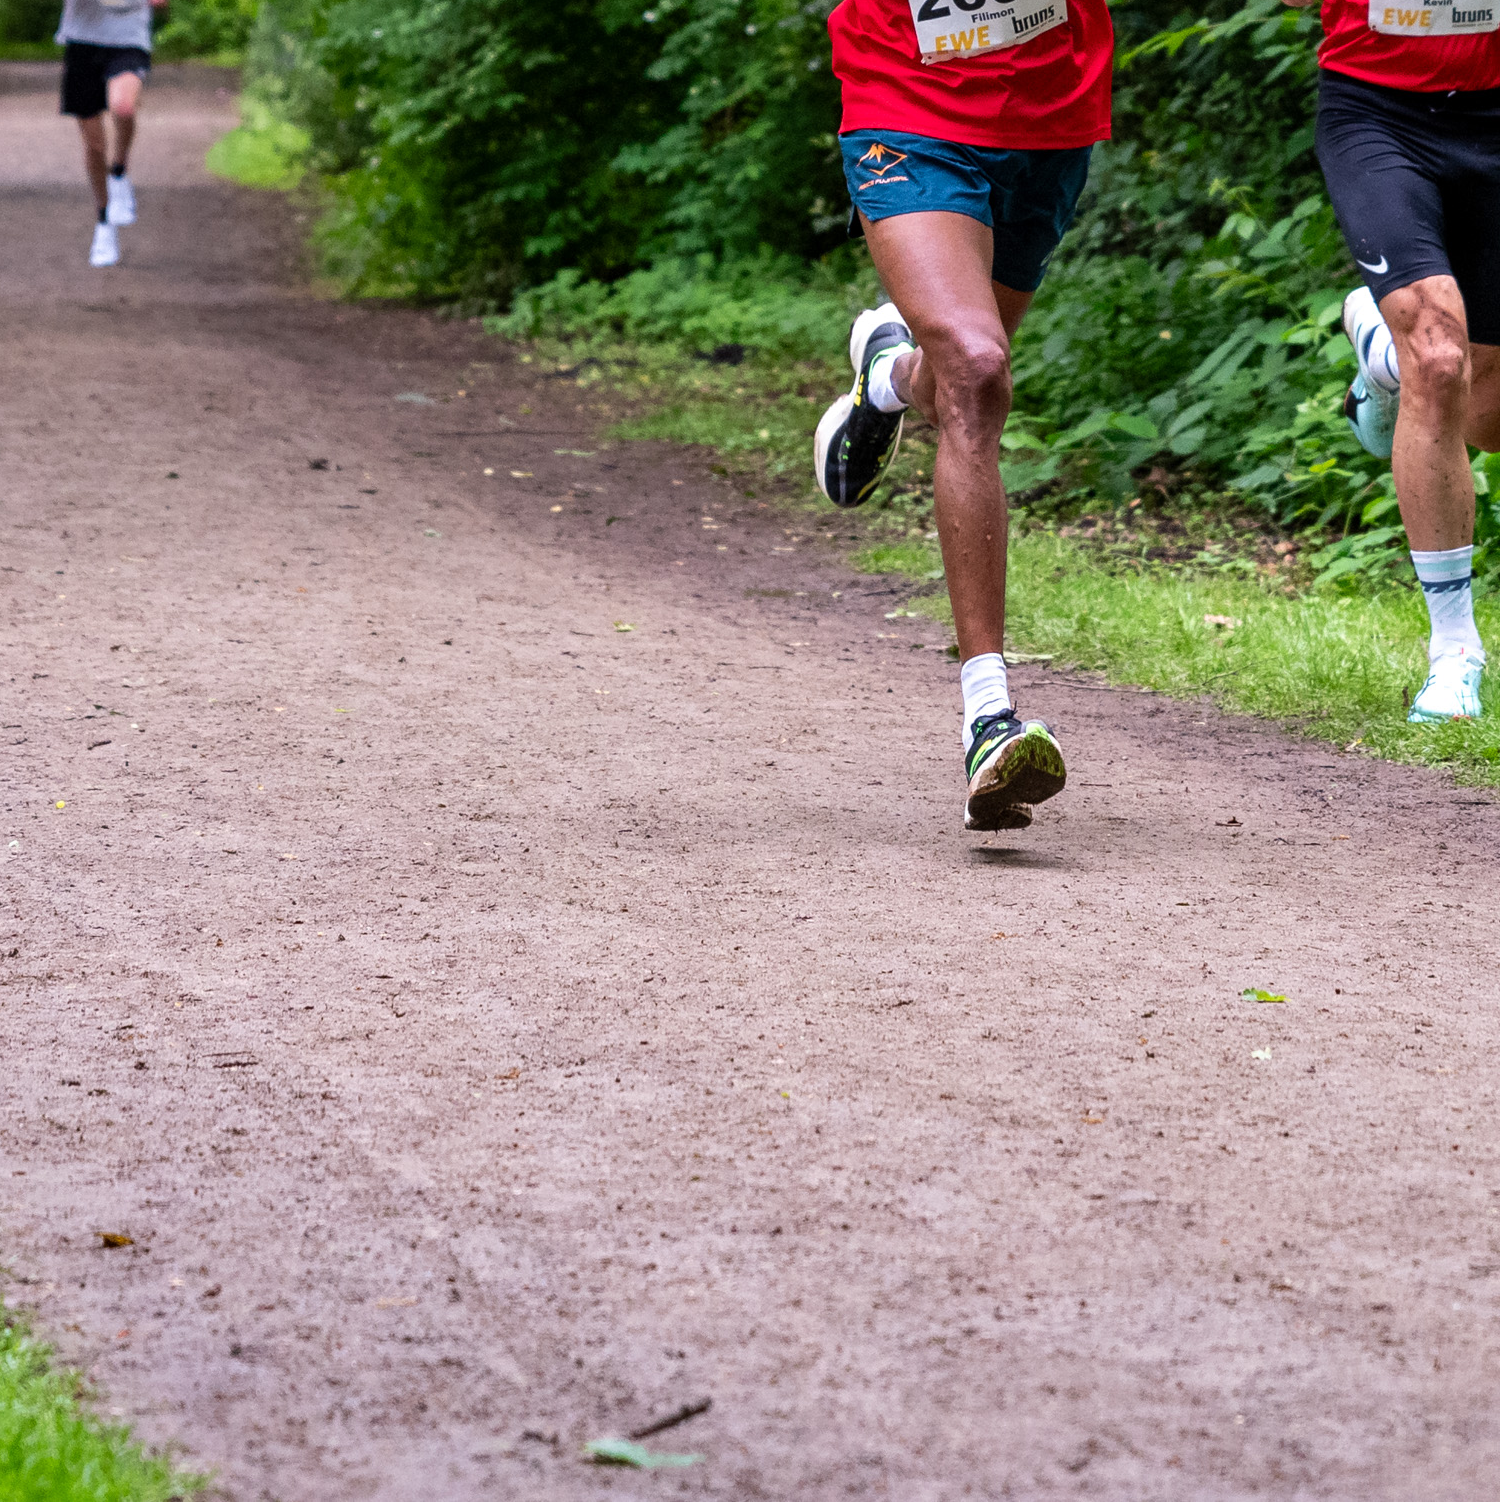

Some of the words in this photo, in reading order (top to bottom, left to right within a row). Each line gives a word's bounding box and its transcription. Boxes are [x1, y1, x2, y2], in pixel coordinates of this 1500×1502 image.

[971, 7, 1015, 23] Filimon
[1011, 4, 1055, 34] bruns
[1382, 7, 1432, 27] EWE
[1452, 7, 1492, 23] bruns
[935, 25, 991, 55] EWE
